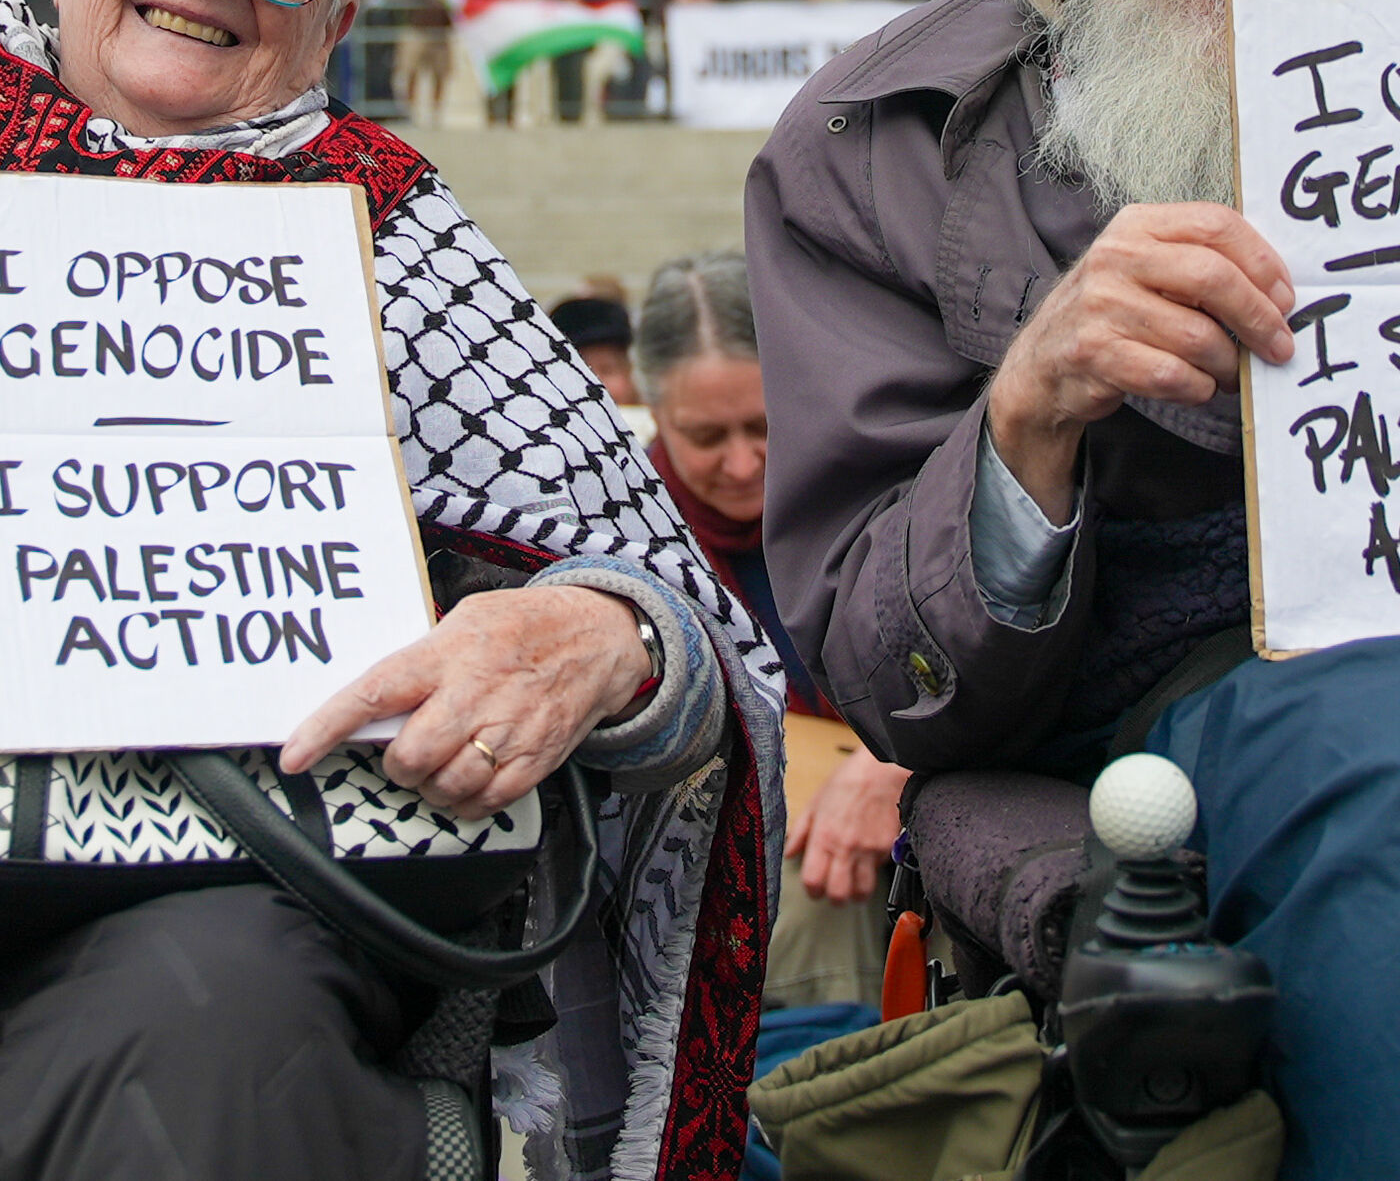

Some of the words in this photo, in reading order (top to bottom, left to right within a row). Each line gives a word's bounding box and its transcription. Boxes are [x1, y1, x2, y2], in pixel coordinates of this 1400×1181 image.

[1273, 40, 1363, 132] I
[66, 250, 308, 307] OPPOSE
[1288, 293, 1357, 387] I
[52, 459, 357, 518] SUPPORT
[17, 542, 365, 603] PALESTINE
[56, 607, 333, 670] ACTION
